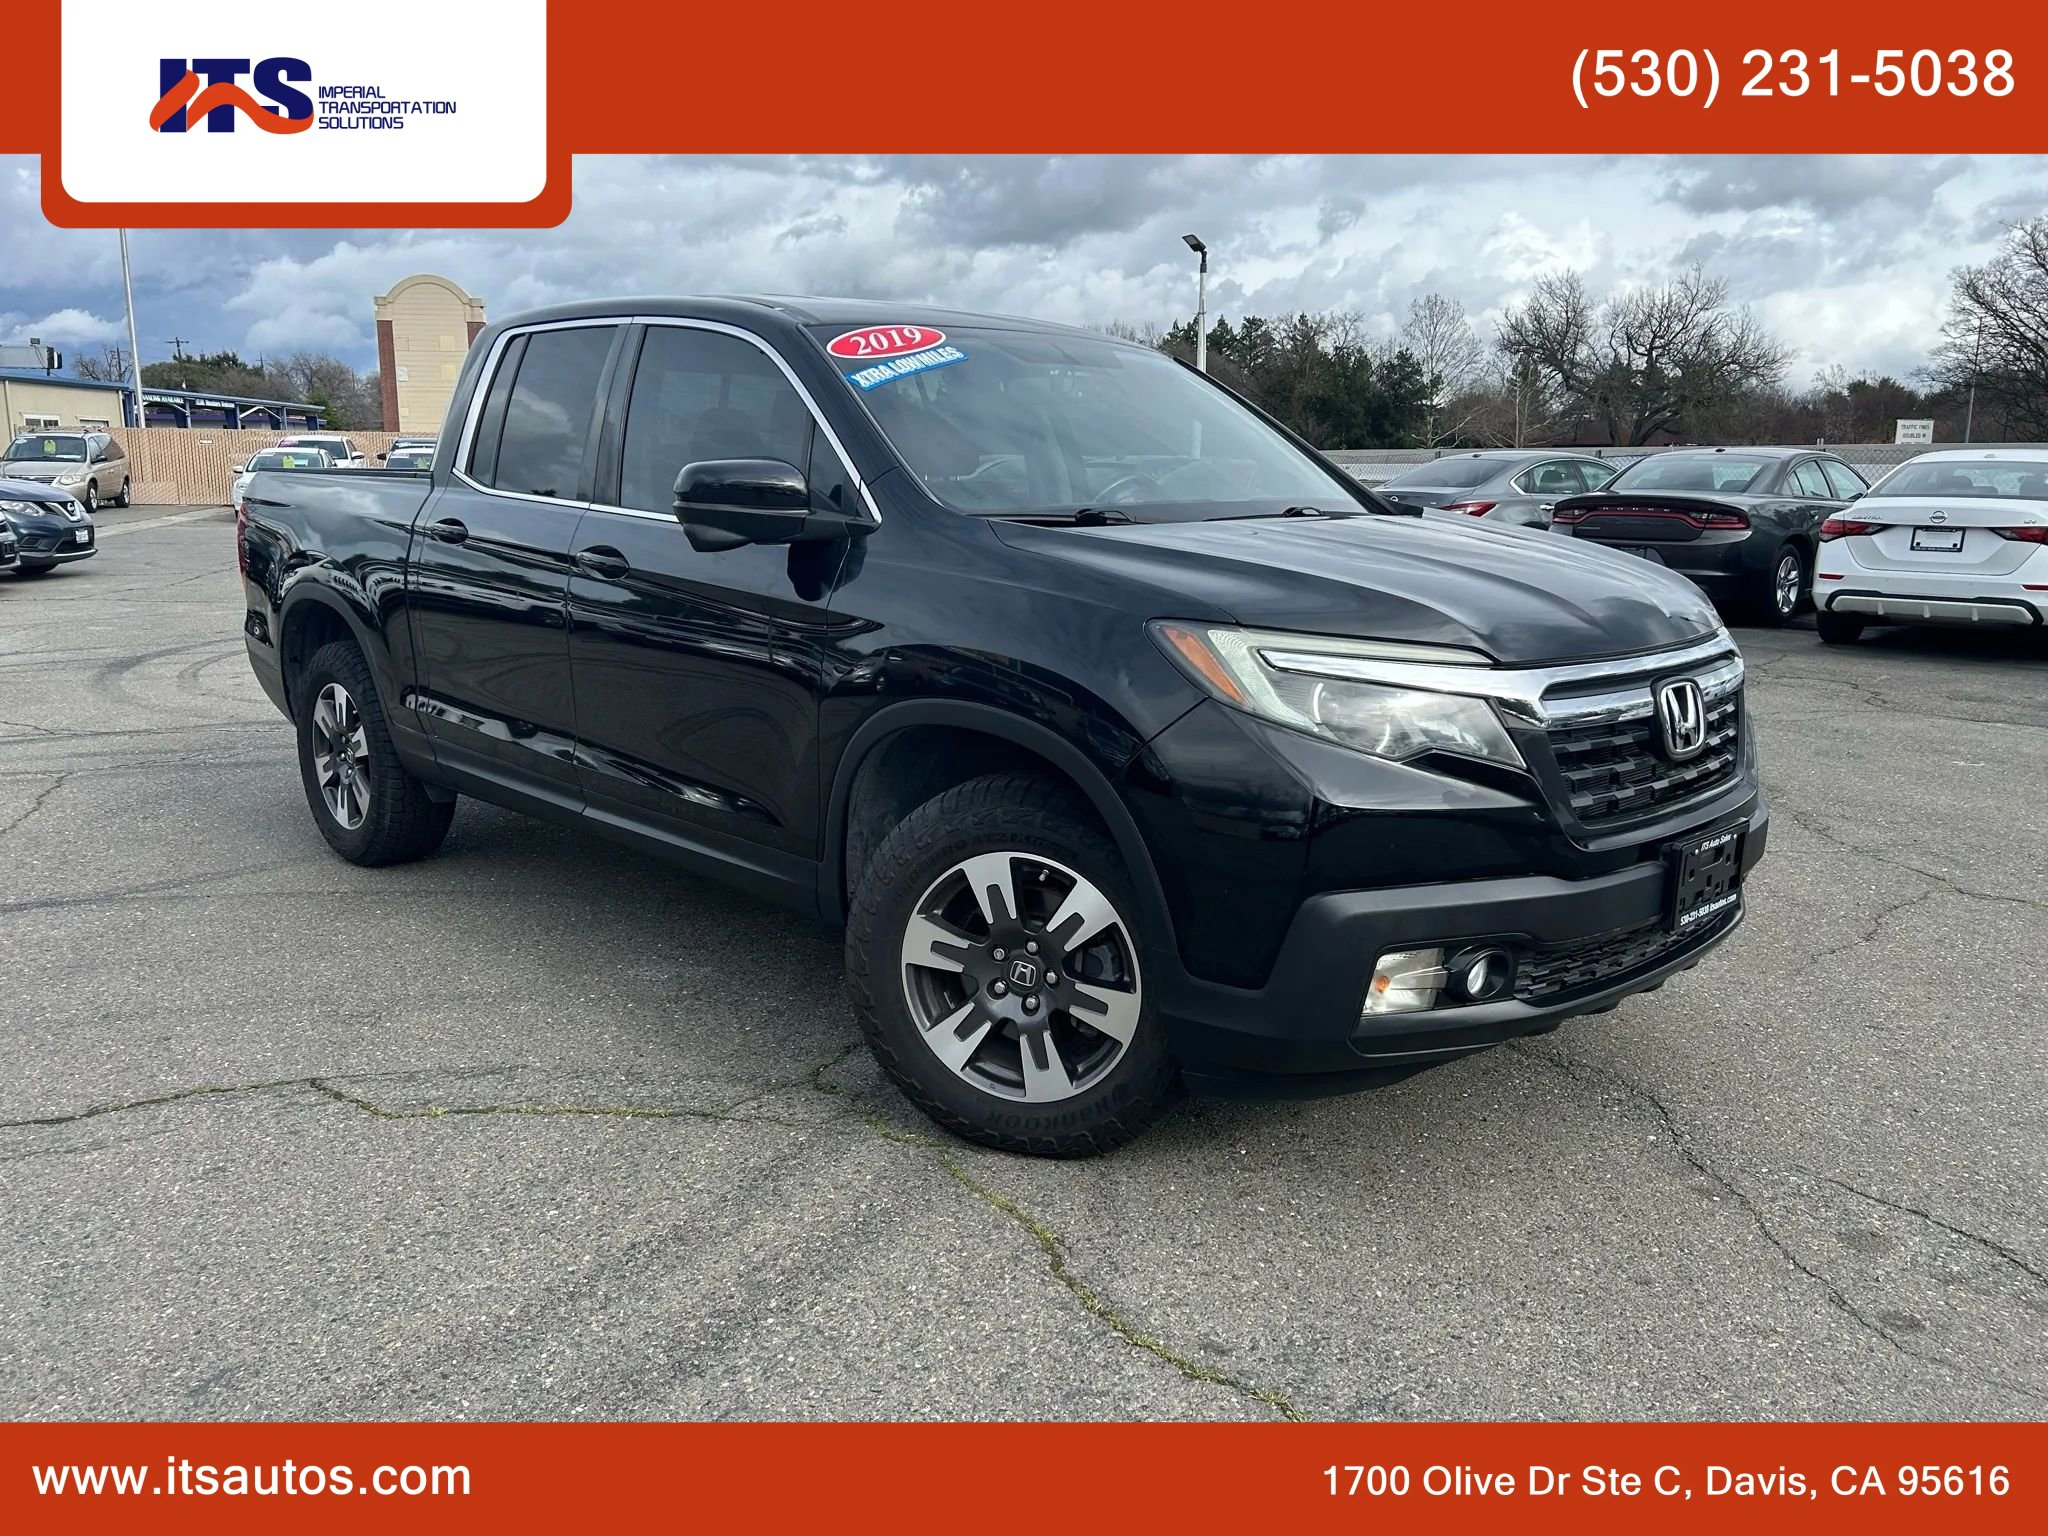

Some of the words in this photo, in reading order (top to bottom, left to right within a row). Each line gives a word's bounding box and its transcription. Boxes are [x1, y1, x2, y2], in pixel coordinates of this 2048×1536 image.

[850, 327, 922, 355] 2019
[851, 363, 893, 388] XTRA
[889, 356, 925, 376] LOW
[917, 346, 965, 368] MILES
[1701, 840, 1710, 852] ITS
[1709, 837, 1720, 848] Auto
[1720, 833, 1732, 844] Sales
[1710, 893, 1737, 912] itsautos.com
